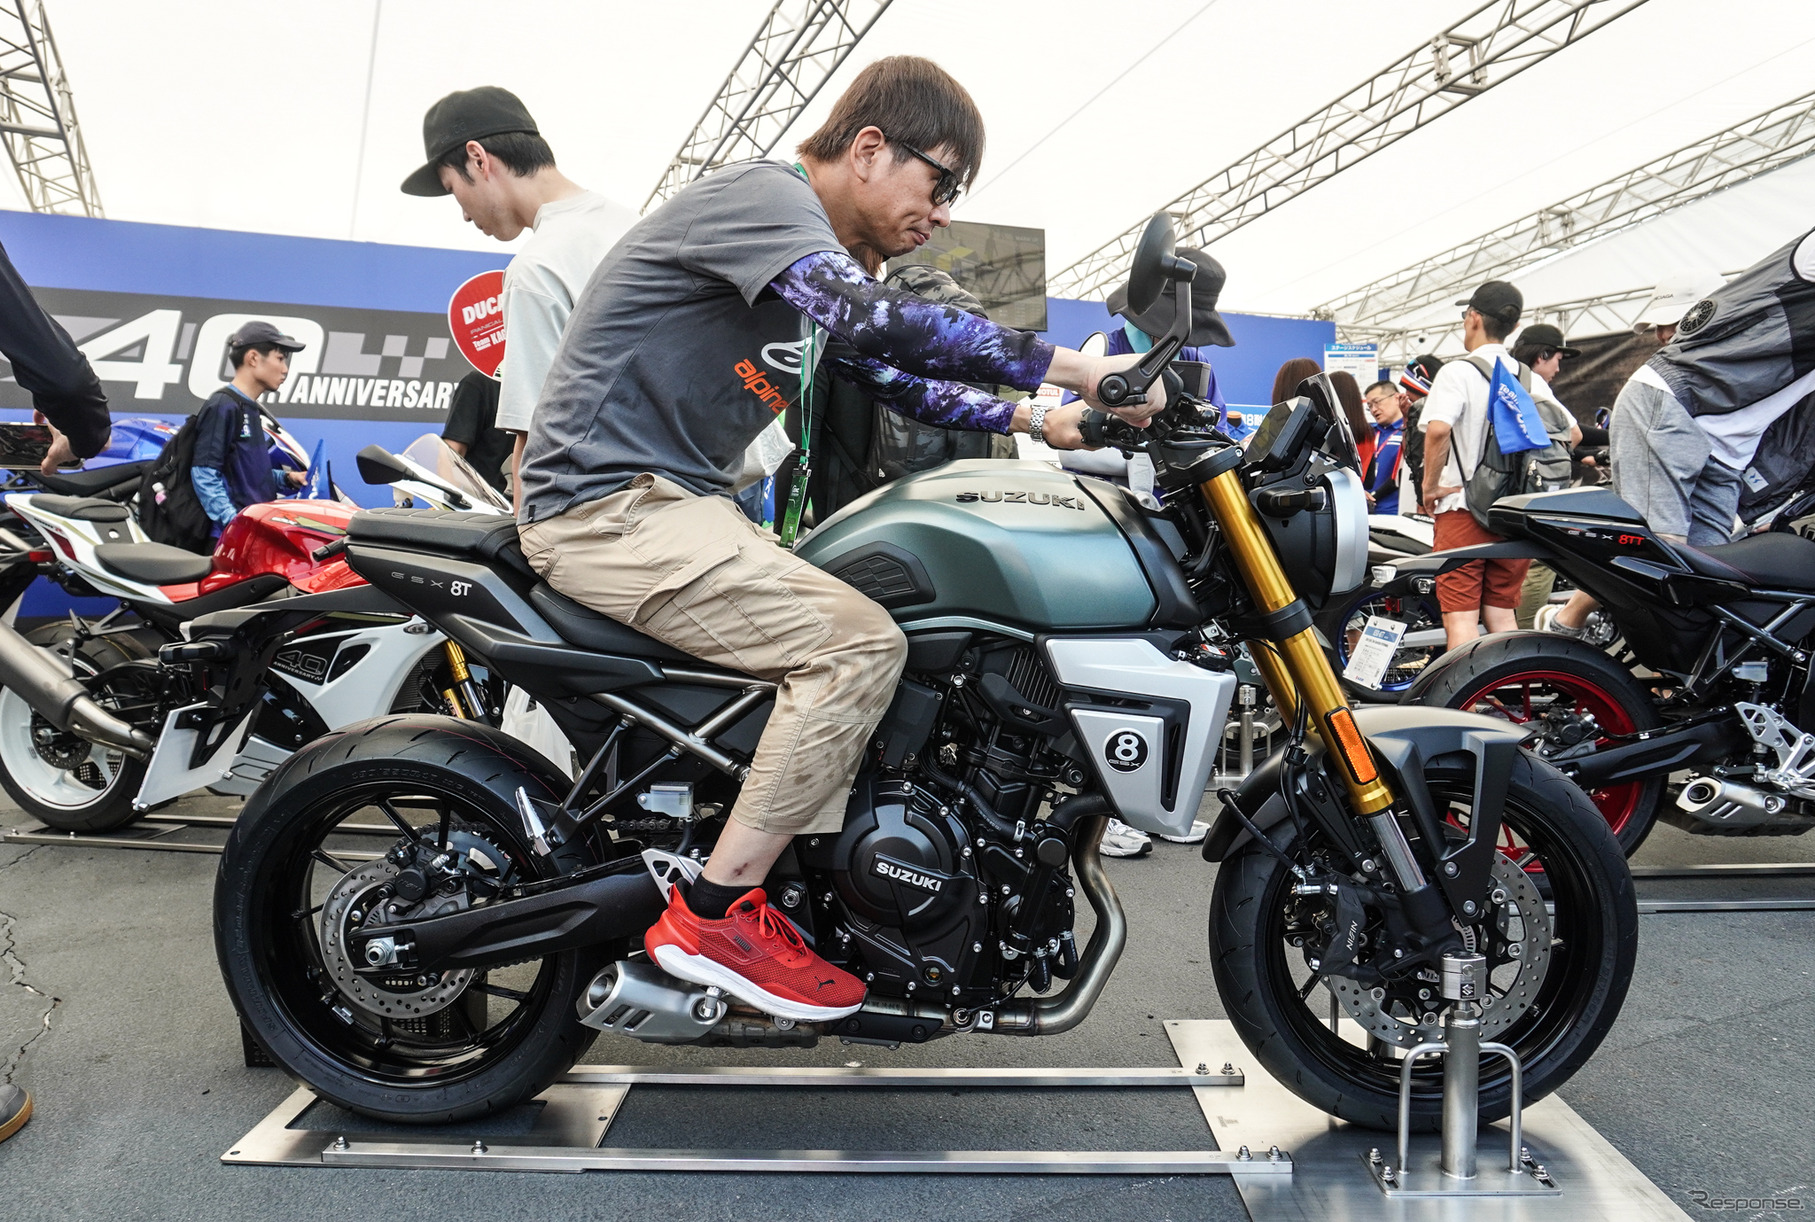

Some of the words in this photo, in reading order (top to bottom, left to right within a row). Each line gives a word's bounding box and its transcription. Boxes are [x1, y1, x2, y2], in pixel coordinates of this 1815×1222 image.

[77, 309, 324, 401] 40
[290, 376, 459, 409] ANNIVERSAR
[955, 490, 1085, 511] SUZUKI
[1618, 534, 1645, 546] 8TT
[450, 580, 473, 596] 8T
[272, 661, 317, 680] ANNIVERSARY
[276, 649, 328, 676] 40
[1114, 734, 1139, 762] 8
[1108, 758, 1141, 768] GSX
[876, 861, 942, 892] SUZUKI
